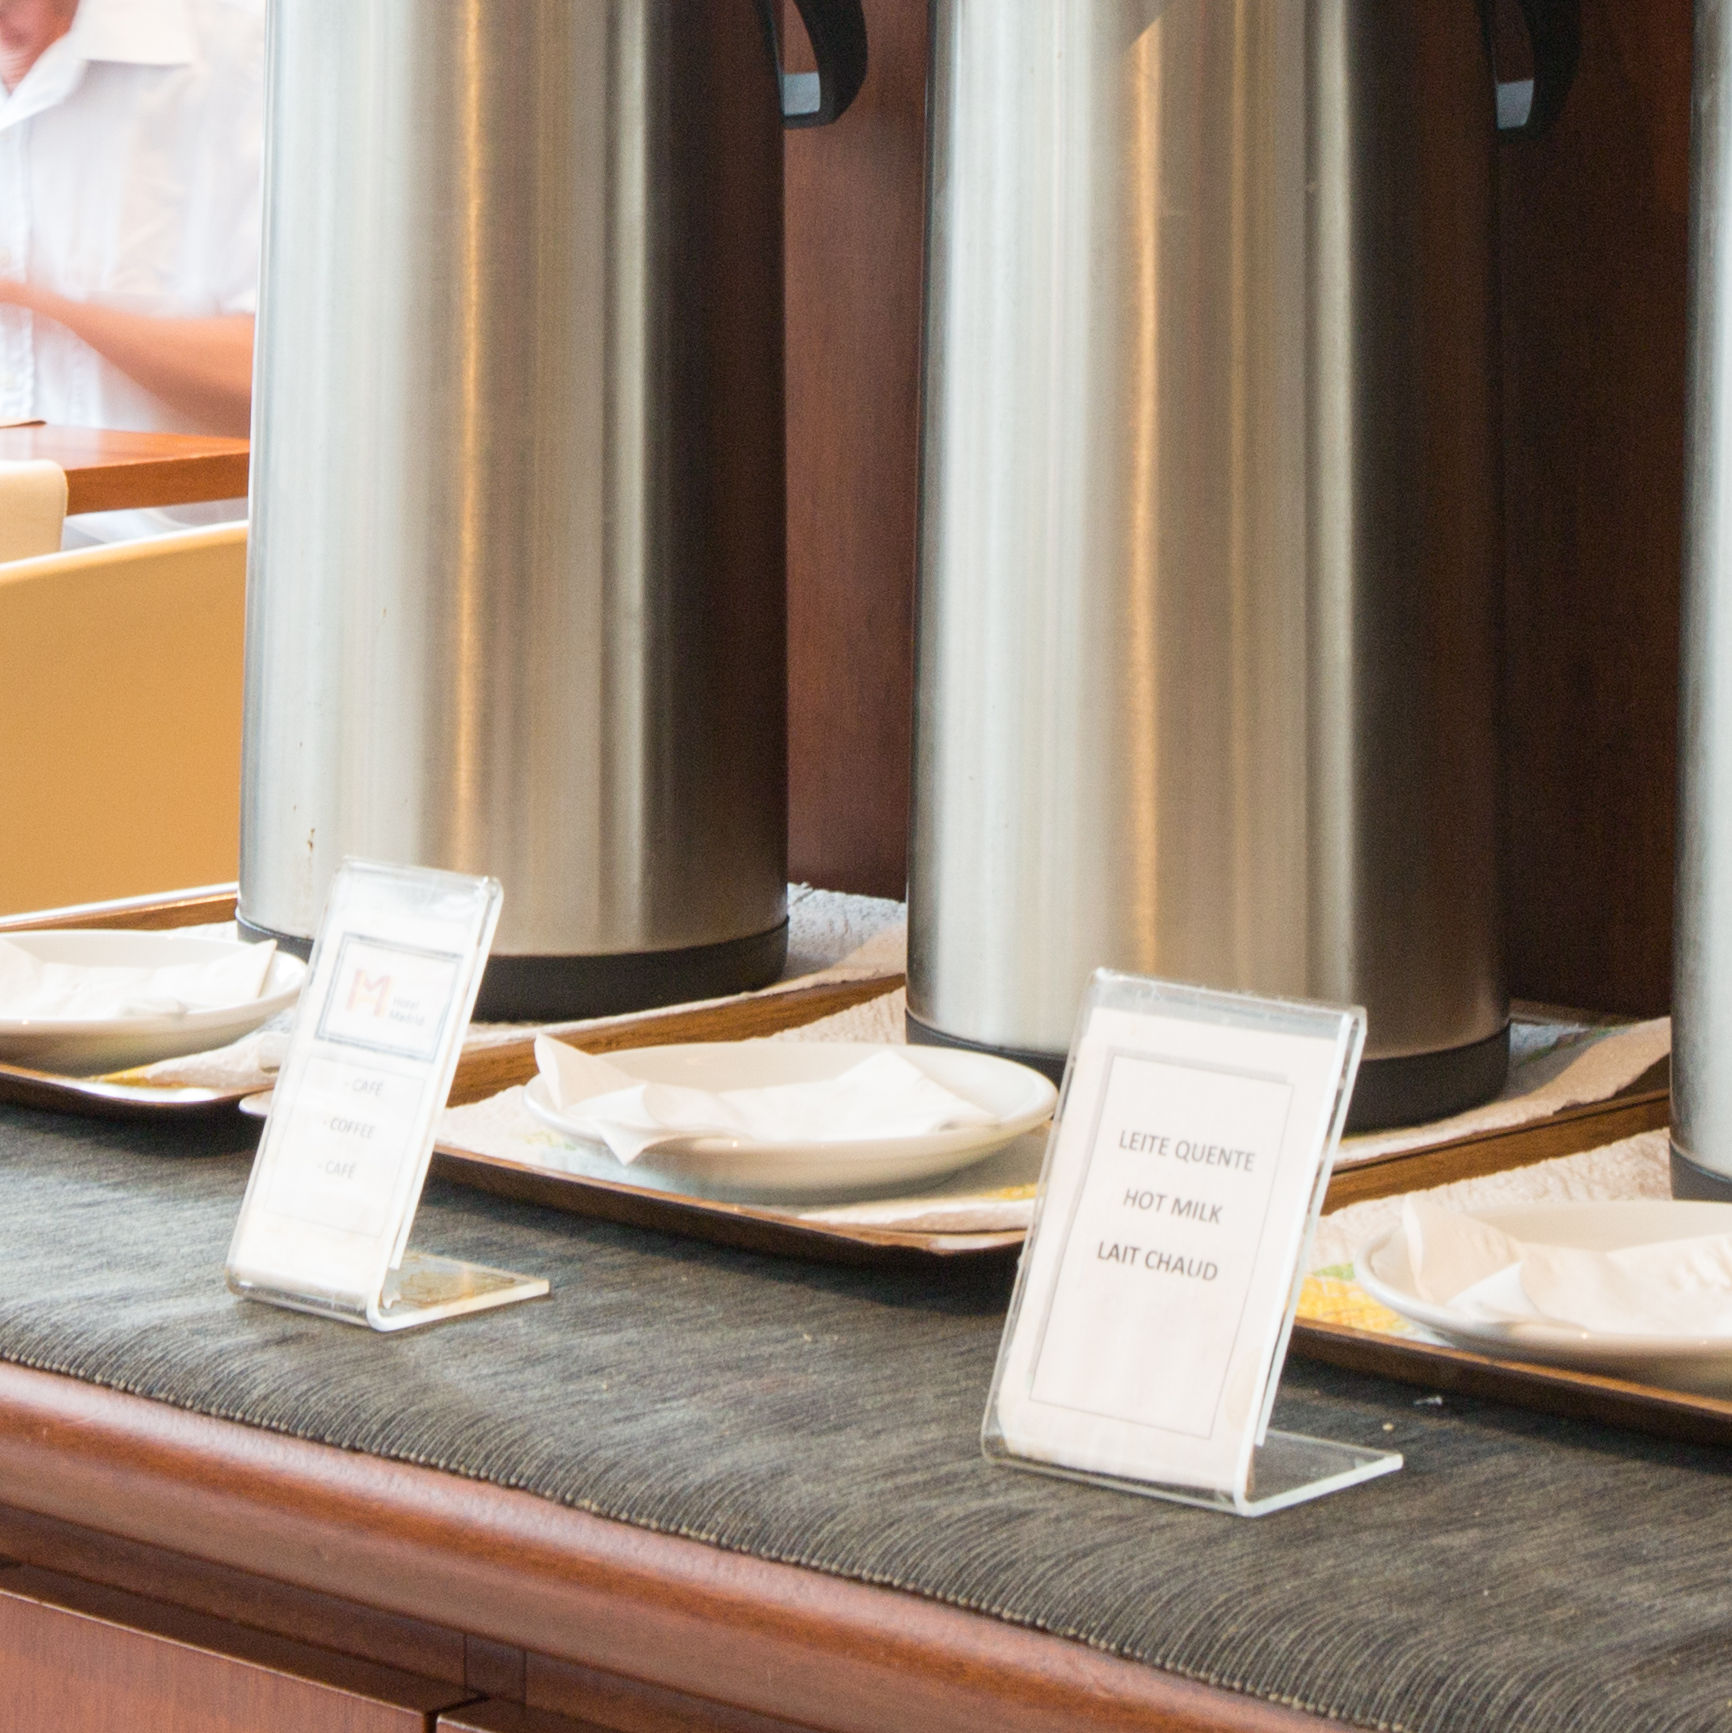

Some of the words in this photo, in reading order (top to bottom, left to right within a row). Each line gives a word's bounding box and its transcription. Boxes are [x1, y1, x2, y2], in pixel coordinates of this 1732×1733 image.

[393, 995, 421, 1011] Hotel
[389, 1009, 426, 1028] Madrid
[353, 1077, 384, 1095] CAFÉ
[330, 1117, 375, 1139] COFFEE
[1119, 1130, 1170, 1156] LEITE
[1175, 1141, 1255, 1171] QUENTE
[325, 1159, 357, 1178] CAFÉ
[1123, 1188, 1167, 1212] HOT
[1170, 1196, 1224, 1225] MILK
[1097, 1240, 1142, 1265] LAIT
[1144, 1249, 1219, 1282] CHAUD
